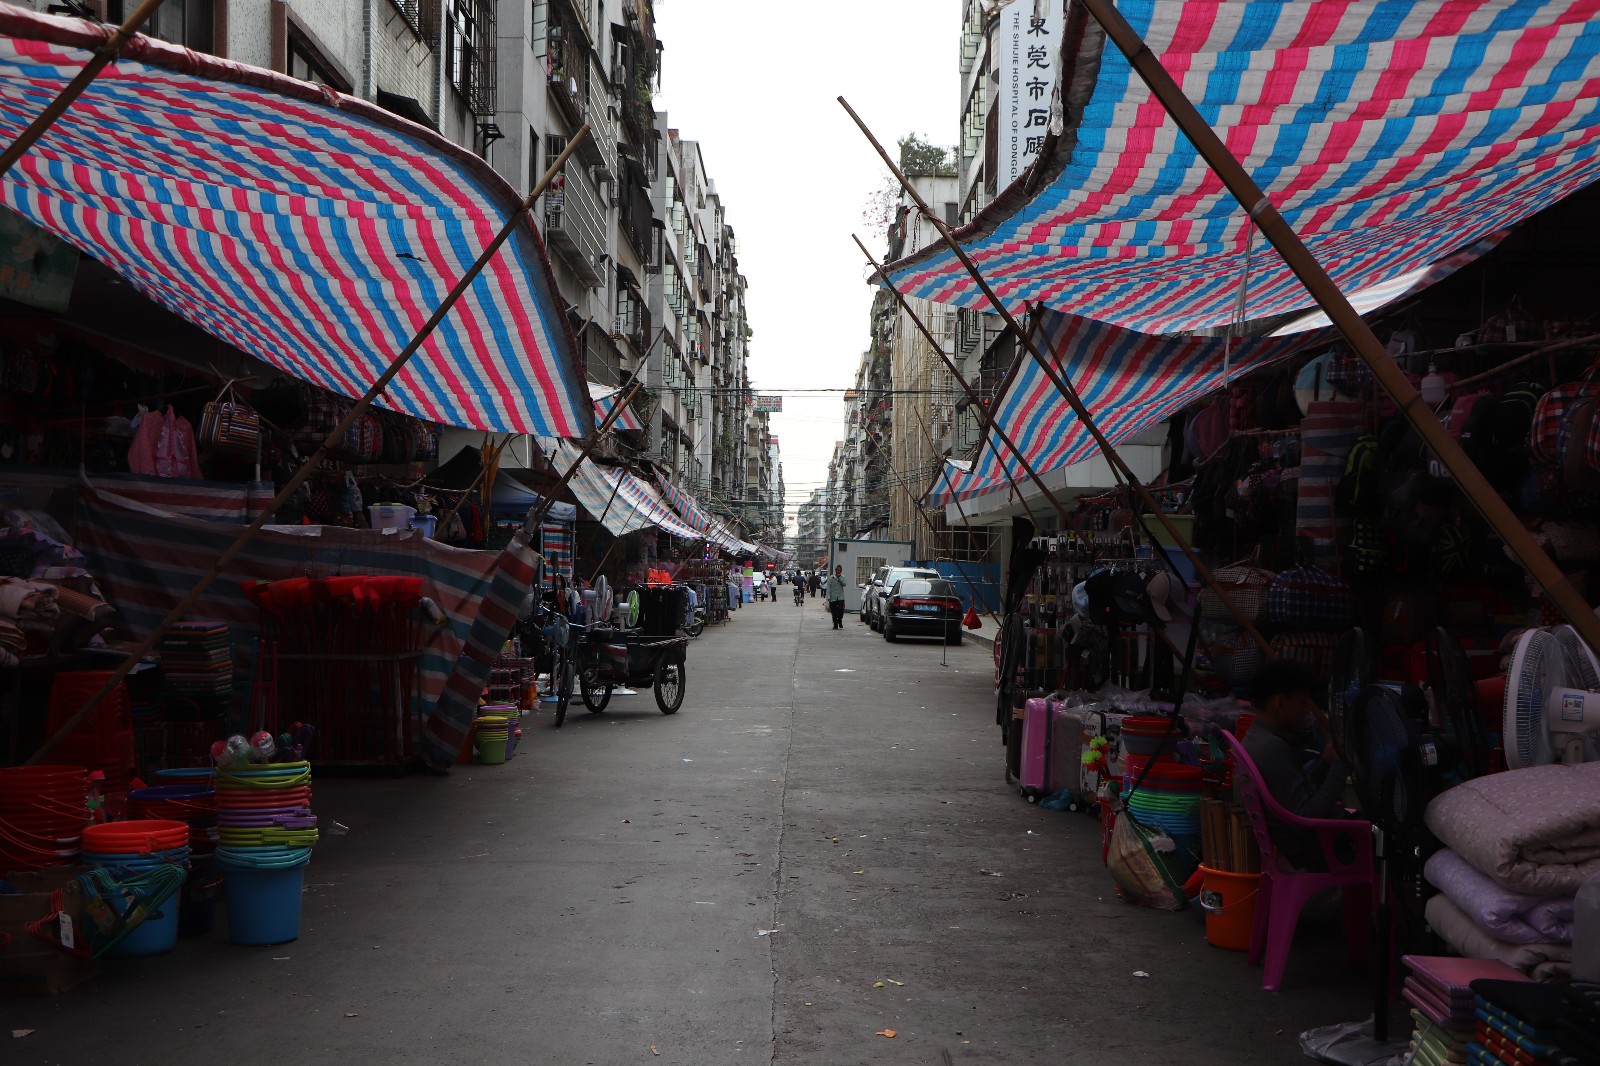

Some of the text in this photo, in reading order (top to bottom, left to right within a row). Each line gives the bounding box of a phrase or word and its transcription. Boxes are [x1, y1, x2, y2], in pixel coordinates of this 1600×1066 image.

[1012, 32, 1020, 65] SHIJIE
[1011, 67, 1019, 118] HOSPITAL
[1022, 15, 1051, 171] 東莞市石碣
[1011, 120, 1018, 134] OF
